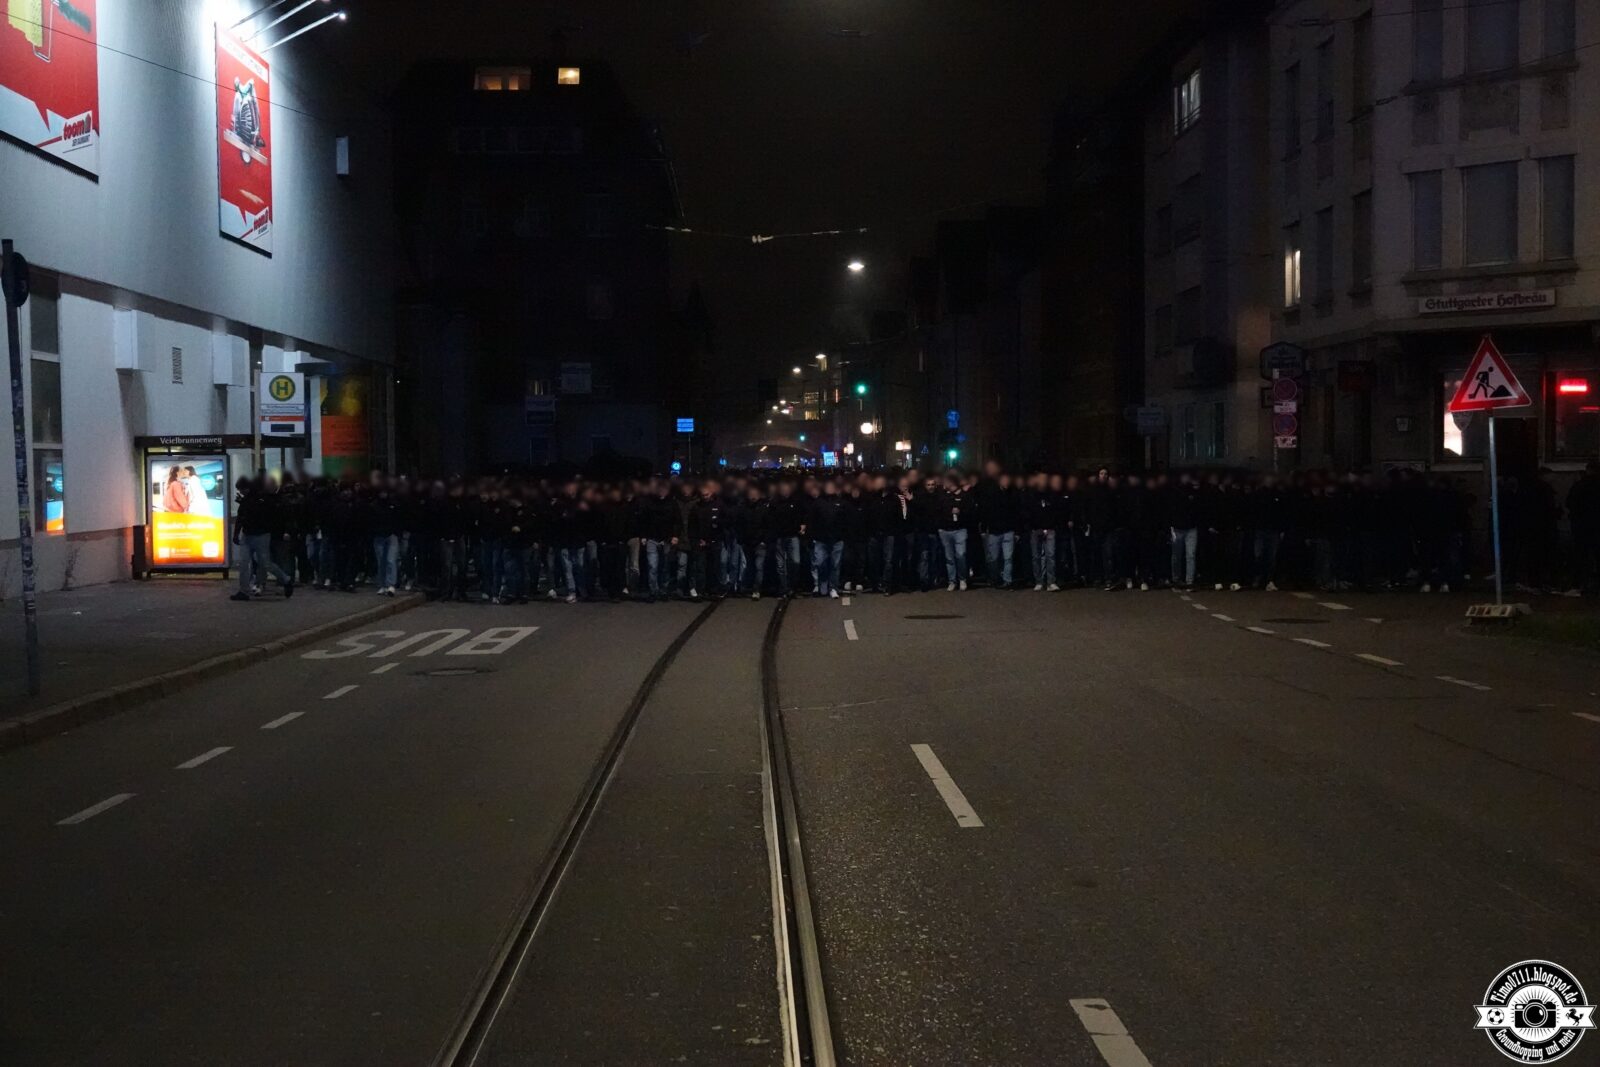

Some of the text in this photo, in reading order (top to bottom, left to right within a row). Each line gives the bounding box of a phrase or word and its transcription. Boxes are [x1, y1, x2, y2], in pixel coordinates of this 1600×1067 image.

[63, 118, 85, 141] toom
[1425, 293, 1547, 310] Stuttgarter Hofbräu
[276, 381, 288, 396] H
[160, 436, 222, 445] Veielbrunnenweg
[300, 626, 540, 660] BUS
